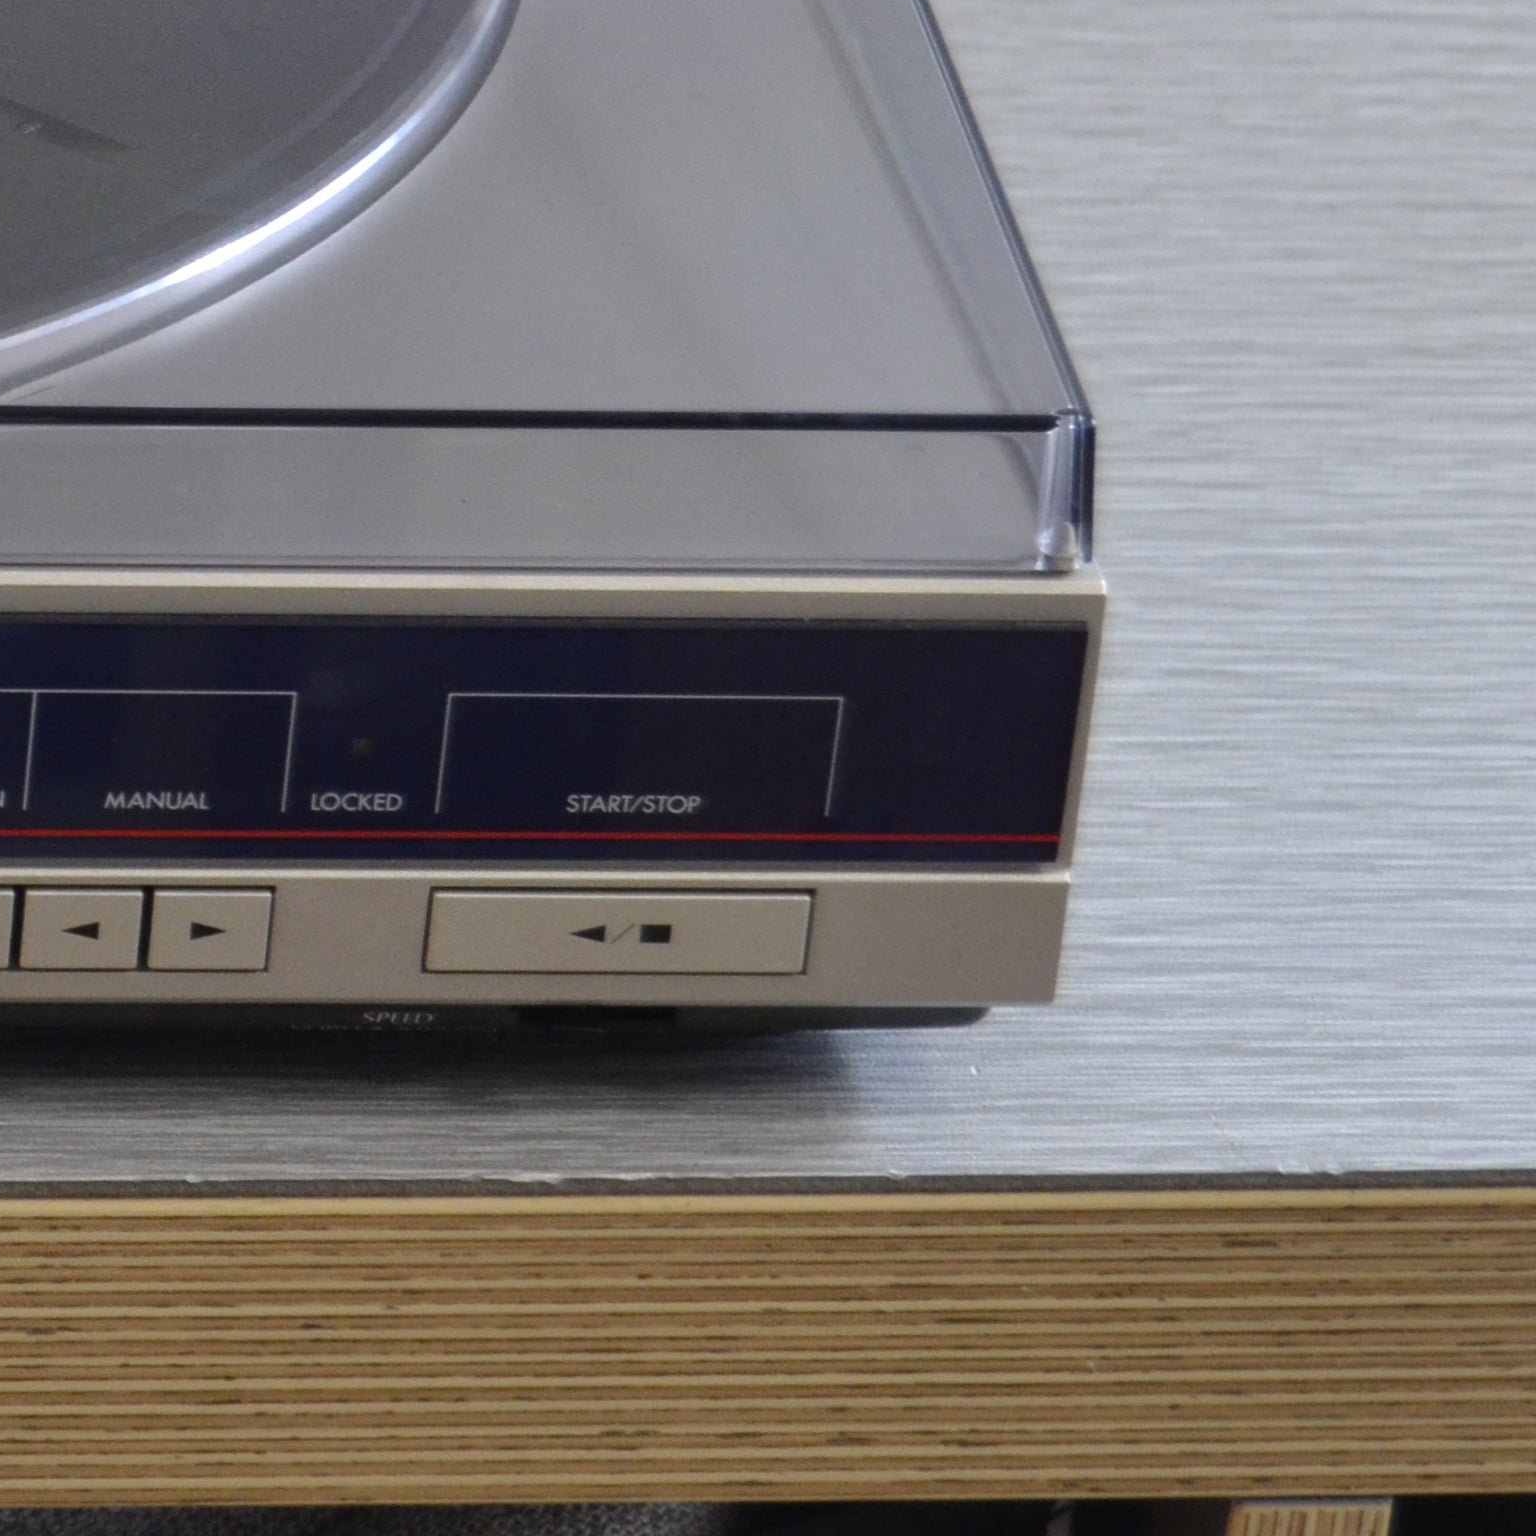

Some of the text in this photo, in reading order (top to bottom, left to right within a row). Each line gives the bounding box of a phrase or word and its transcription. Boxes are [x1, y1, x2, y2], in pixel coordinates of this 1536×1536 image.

[103, 791, 211, 810] MANUAL
[310, 792, 403, 812] LOCKED
[565, 794, 702, 815] START/STOP
[362, 1010, 435, 1025] SPEED
